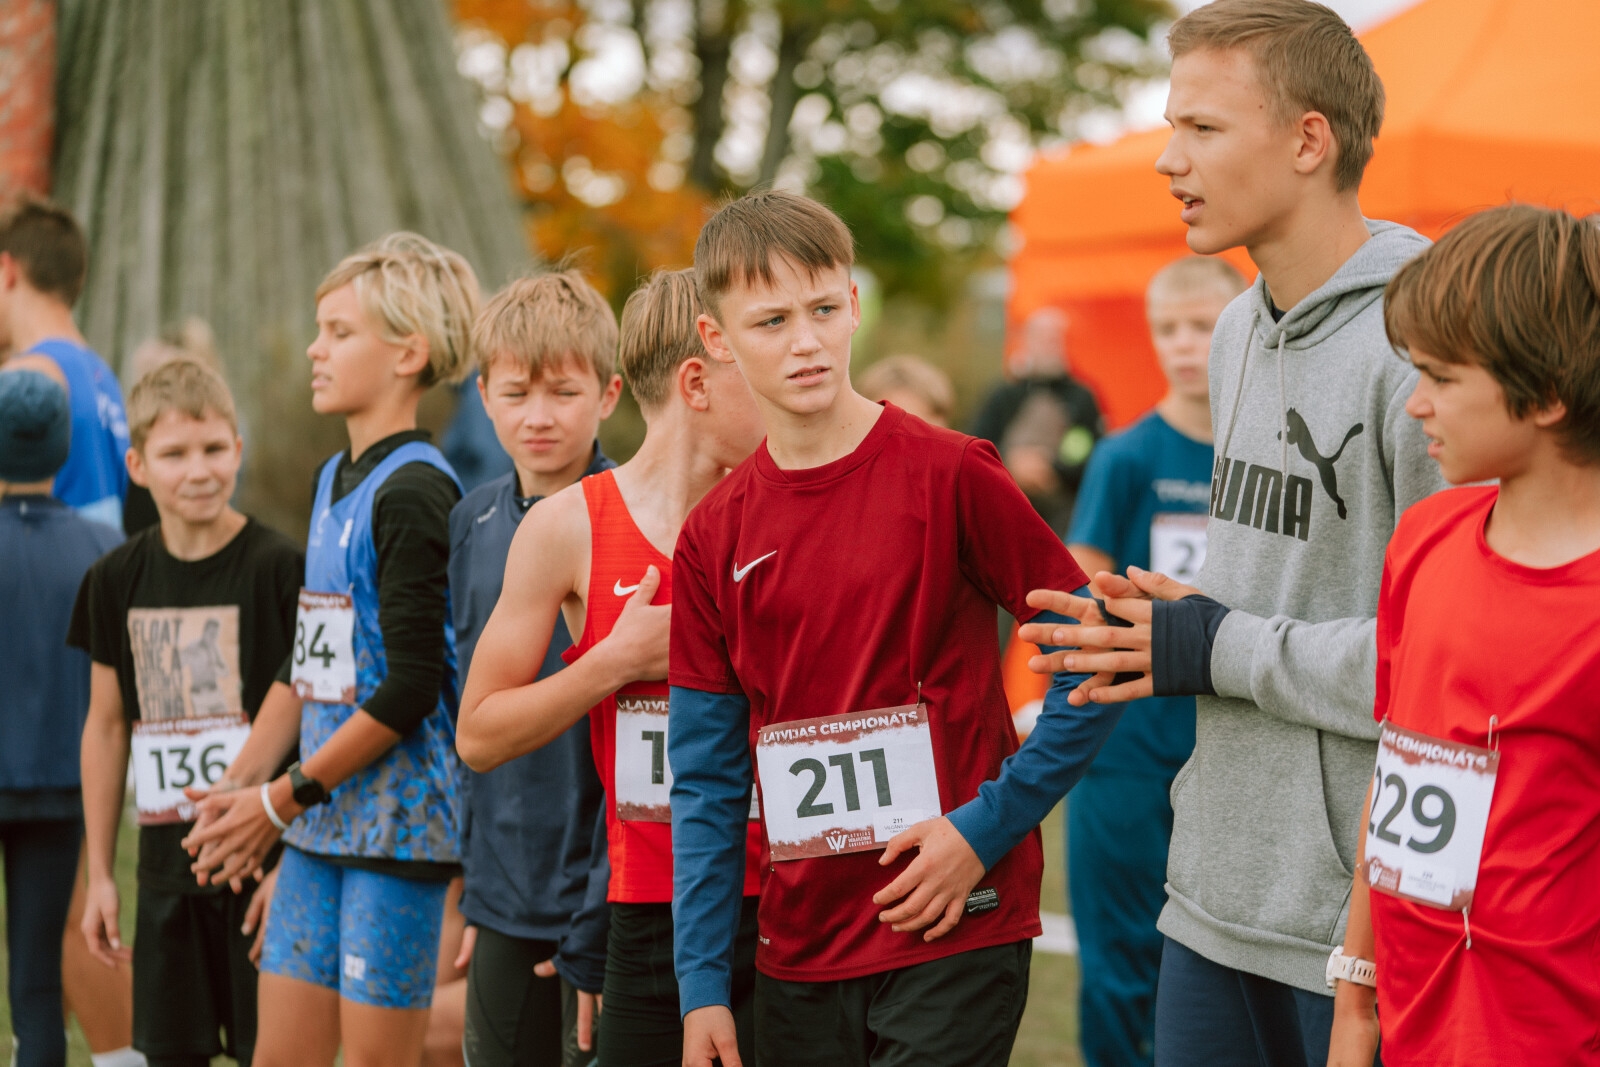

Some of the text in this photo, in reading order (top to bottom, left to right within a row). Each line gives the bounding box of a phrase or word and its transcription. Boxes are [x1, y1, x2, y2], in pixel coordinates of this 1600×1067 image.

[132, 618, 183, 645] FLOAT
[763, 710, 919, 744] LATVIJAS ČEMPIONĀTS
[150, 744, 228, 790] 136
[788, 747, 893, 819] 211
[1369, 765, 1457, 854] 229
[968, 888, 995, 898] UTHENTIC
